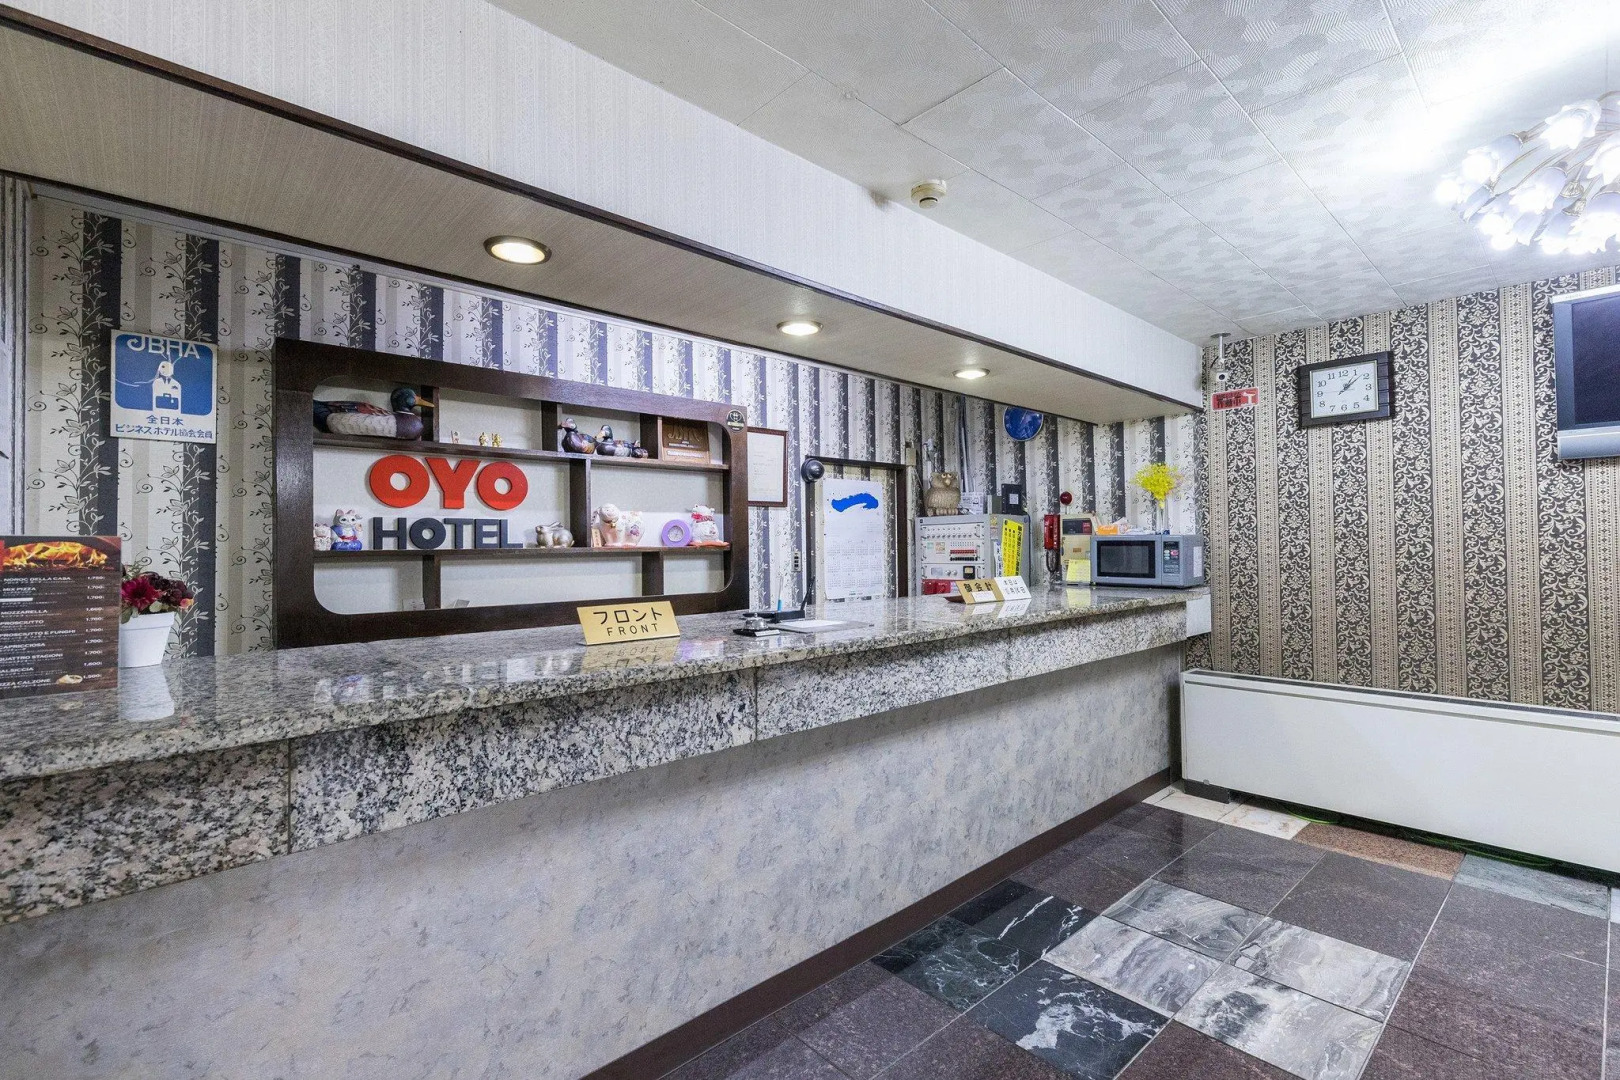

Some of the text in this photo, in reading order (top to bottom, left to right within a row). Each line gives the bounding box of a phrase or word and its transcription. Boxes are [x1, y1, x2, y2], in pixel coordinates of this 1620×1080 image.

[126, 336, 200, 359] JBHA
[1338, 369, 1349, 377] 12
[146, 414, 184, 425] 全日本
[115, 424, 213, 439] ビジネスホテル協会会員
[369, 454, 528, 510] OYO
[372, 516, 524, 550] HOTEL
[593, 607, 662, 624] フロント
[607, 623, 658, 636] FRONT
